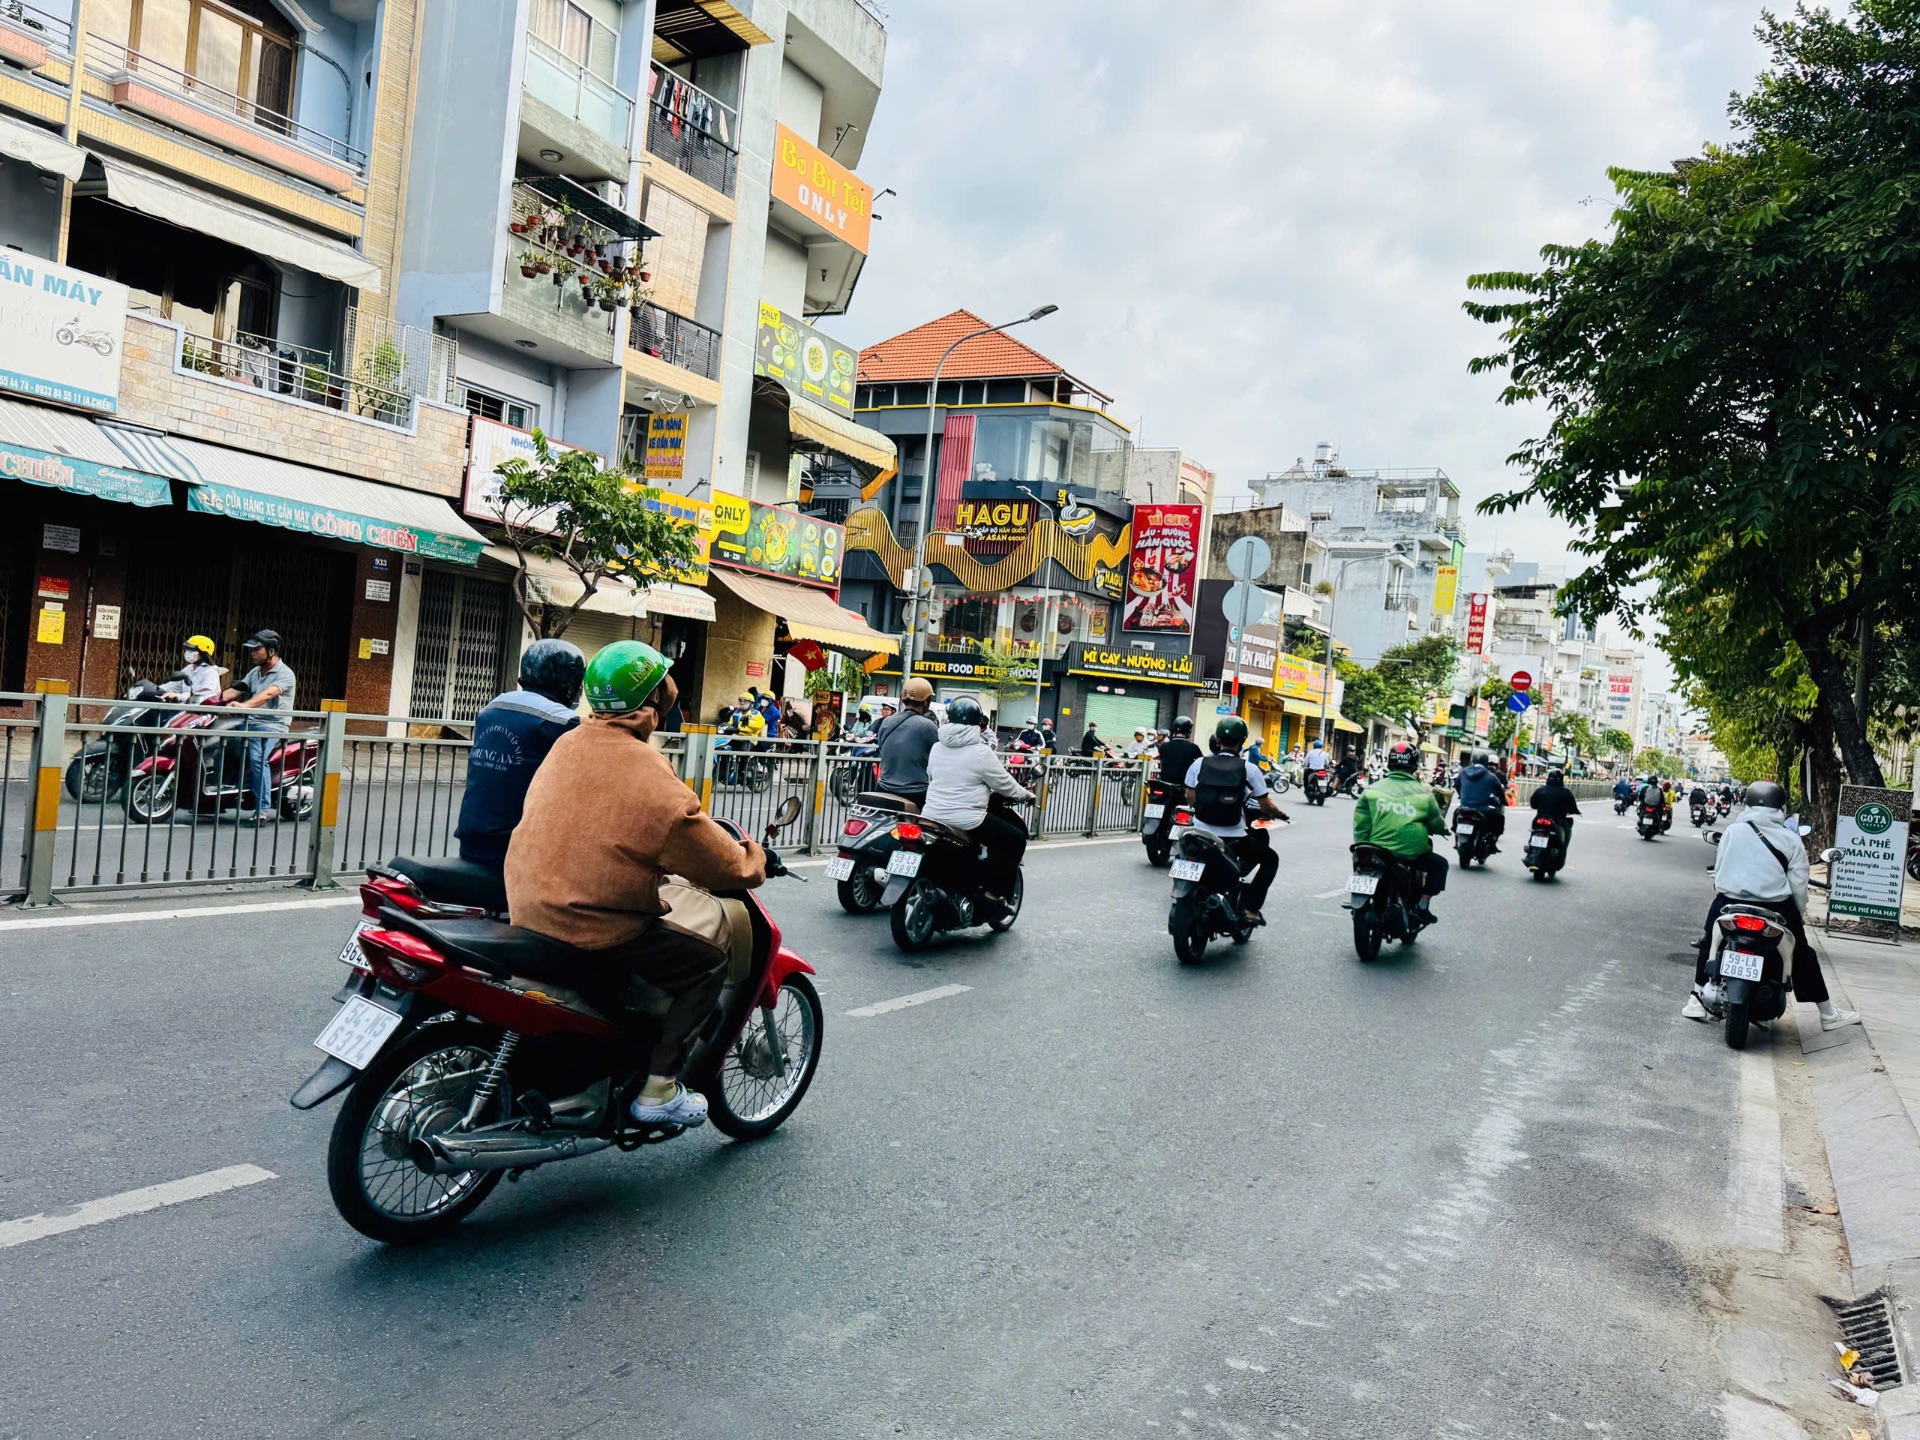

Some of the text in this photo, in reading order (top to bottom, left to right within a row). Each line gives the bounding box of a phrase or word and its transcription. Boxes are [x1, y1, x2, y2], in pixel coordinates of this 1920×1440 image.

[798, 184, 848, 230] ONLY
[842, 181, 865, 217] Tết
[43, 274, 102, 306] MÁY
[760, 308, 778, 321] ONLY
[34, 384, 52, 396] 0933
[63, 390, 73, 400] 55
[73, 392, 81, 402] 11
[225, 491, 241, 509] CỬA
[243, 496, 264, 515] HÀNG
[266, 502, 276, 517] XE
[294, 507, 310, 524] MÁY
[714, 505, 746, 522] ONLY
[956, 503, 1029, 526] HAGU
[312, 511, 362, 541] CÔNG
[374, 558, 387, 567] 933
[1104, 570, 1123, 587] HAGU
[1083, 647, 1098, 663] MÌ
[1099, 652, 1121, 666] CAY
[1126, 653, 1166, 671] NƯỚNG
[1172, 655, 1193, 675] LẨU
[914, 661, 946, 673] BETTER
[947, 663, 973, 674] FOOD
[1009, 667, 1039, 679] MOOD
[1376, 797, 1417, 817] Grab
[1860, 813, 1887, 824] GOTA
[1869, 839, 1891, 849] PHÊ
[1845, 848, 1895, 861] MANG ĐI
[1831, 903, 1848, 911] 100%
[1870, 907, 1883, 915] PHA
[1728, 953, 1757, 968] 59-LA
[1724, 964, 1759, 979] 288.59
